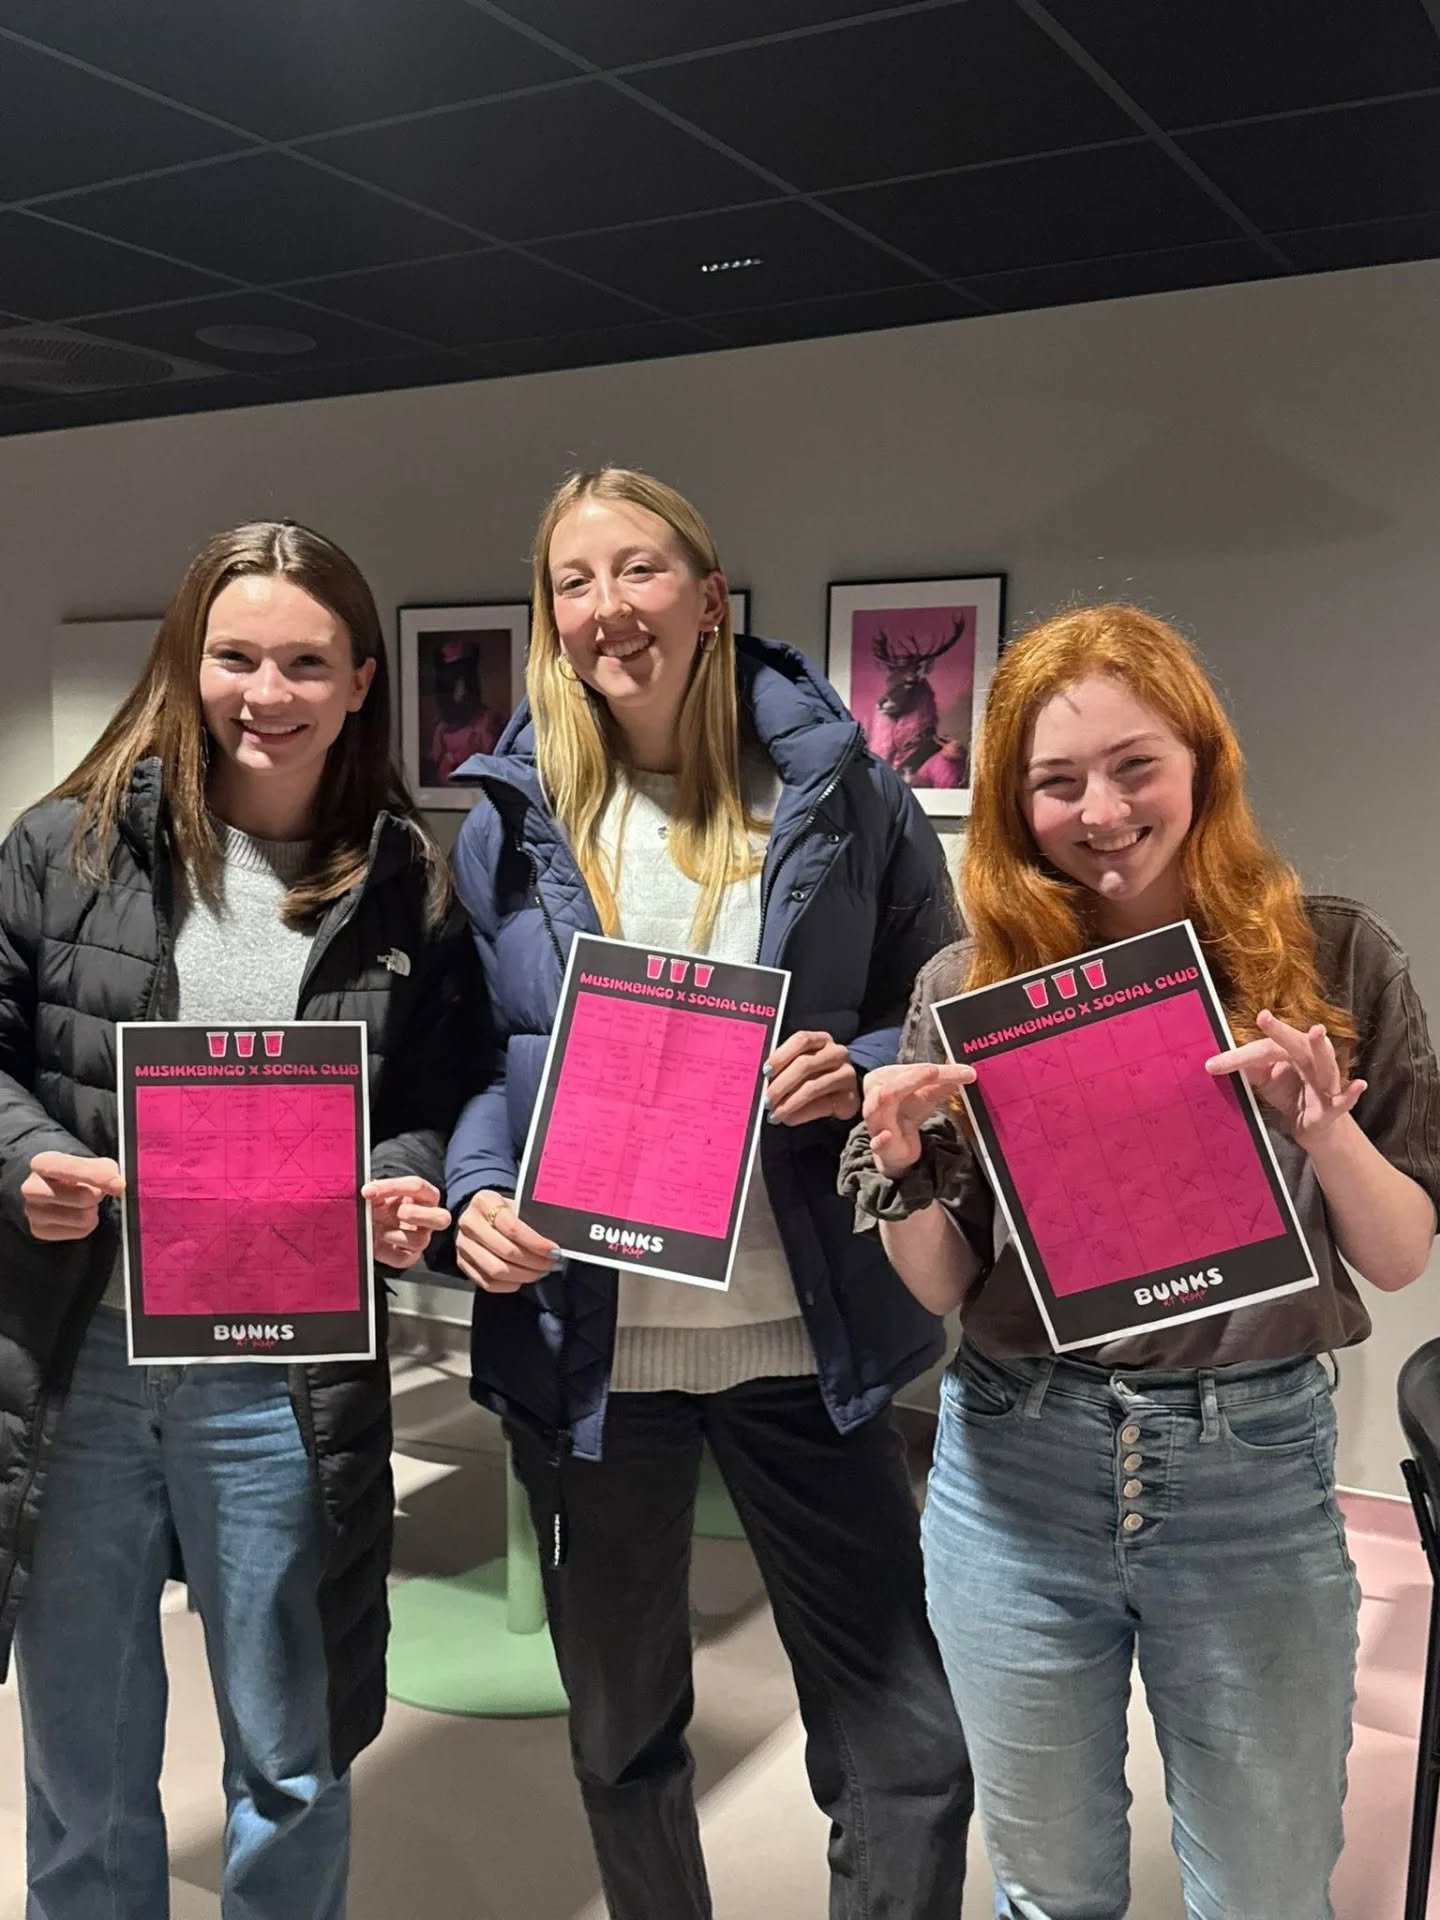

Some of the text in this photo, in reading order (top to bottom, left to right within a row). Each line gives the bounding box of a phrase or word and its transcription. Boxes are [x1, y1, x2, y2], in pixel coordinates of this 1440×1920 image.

[580, 972, 674, 1000] MUSIKKBINGO
[688, 992, 738, 1012] SOCIAL
[739, 1001, 777, 1018] CLUB
[962, 1006, 1076, 1055] MUSIKKBINGO
[1093, 982, 1154, 1011] SOCIAL
[1154, 966, 1200, 990] CLUB
[135, 1064, 246, 1077] MUSIKKBINGO
[263, 1063, 317, 1076] SOCIAL
[320, 1063, 359, 1076] CLUB
[589, 1223, 664, 1253] BUNKS
[1133, 1267, 1224, 1306] BUNKS
[213, 1324, 295, 1341] BUNKS
